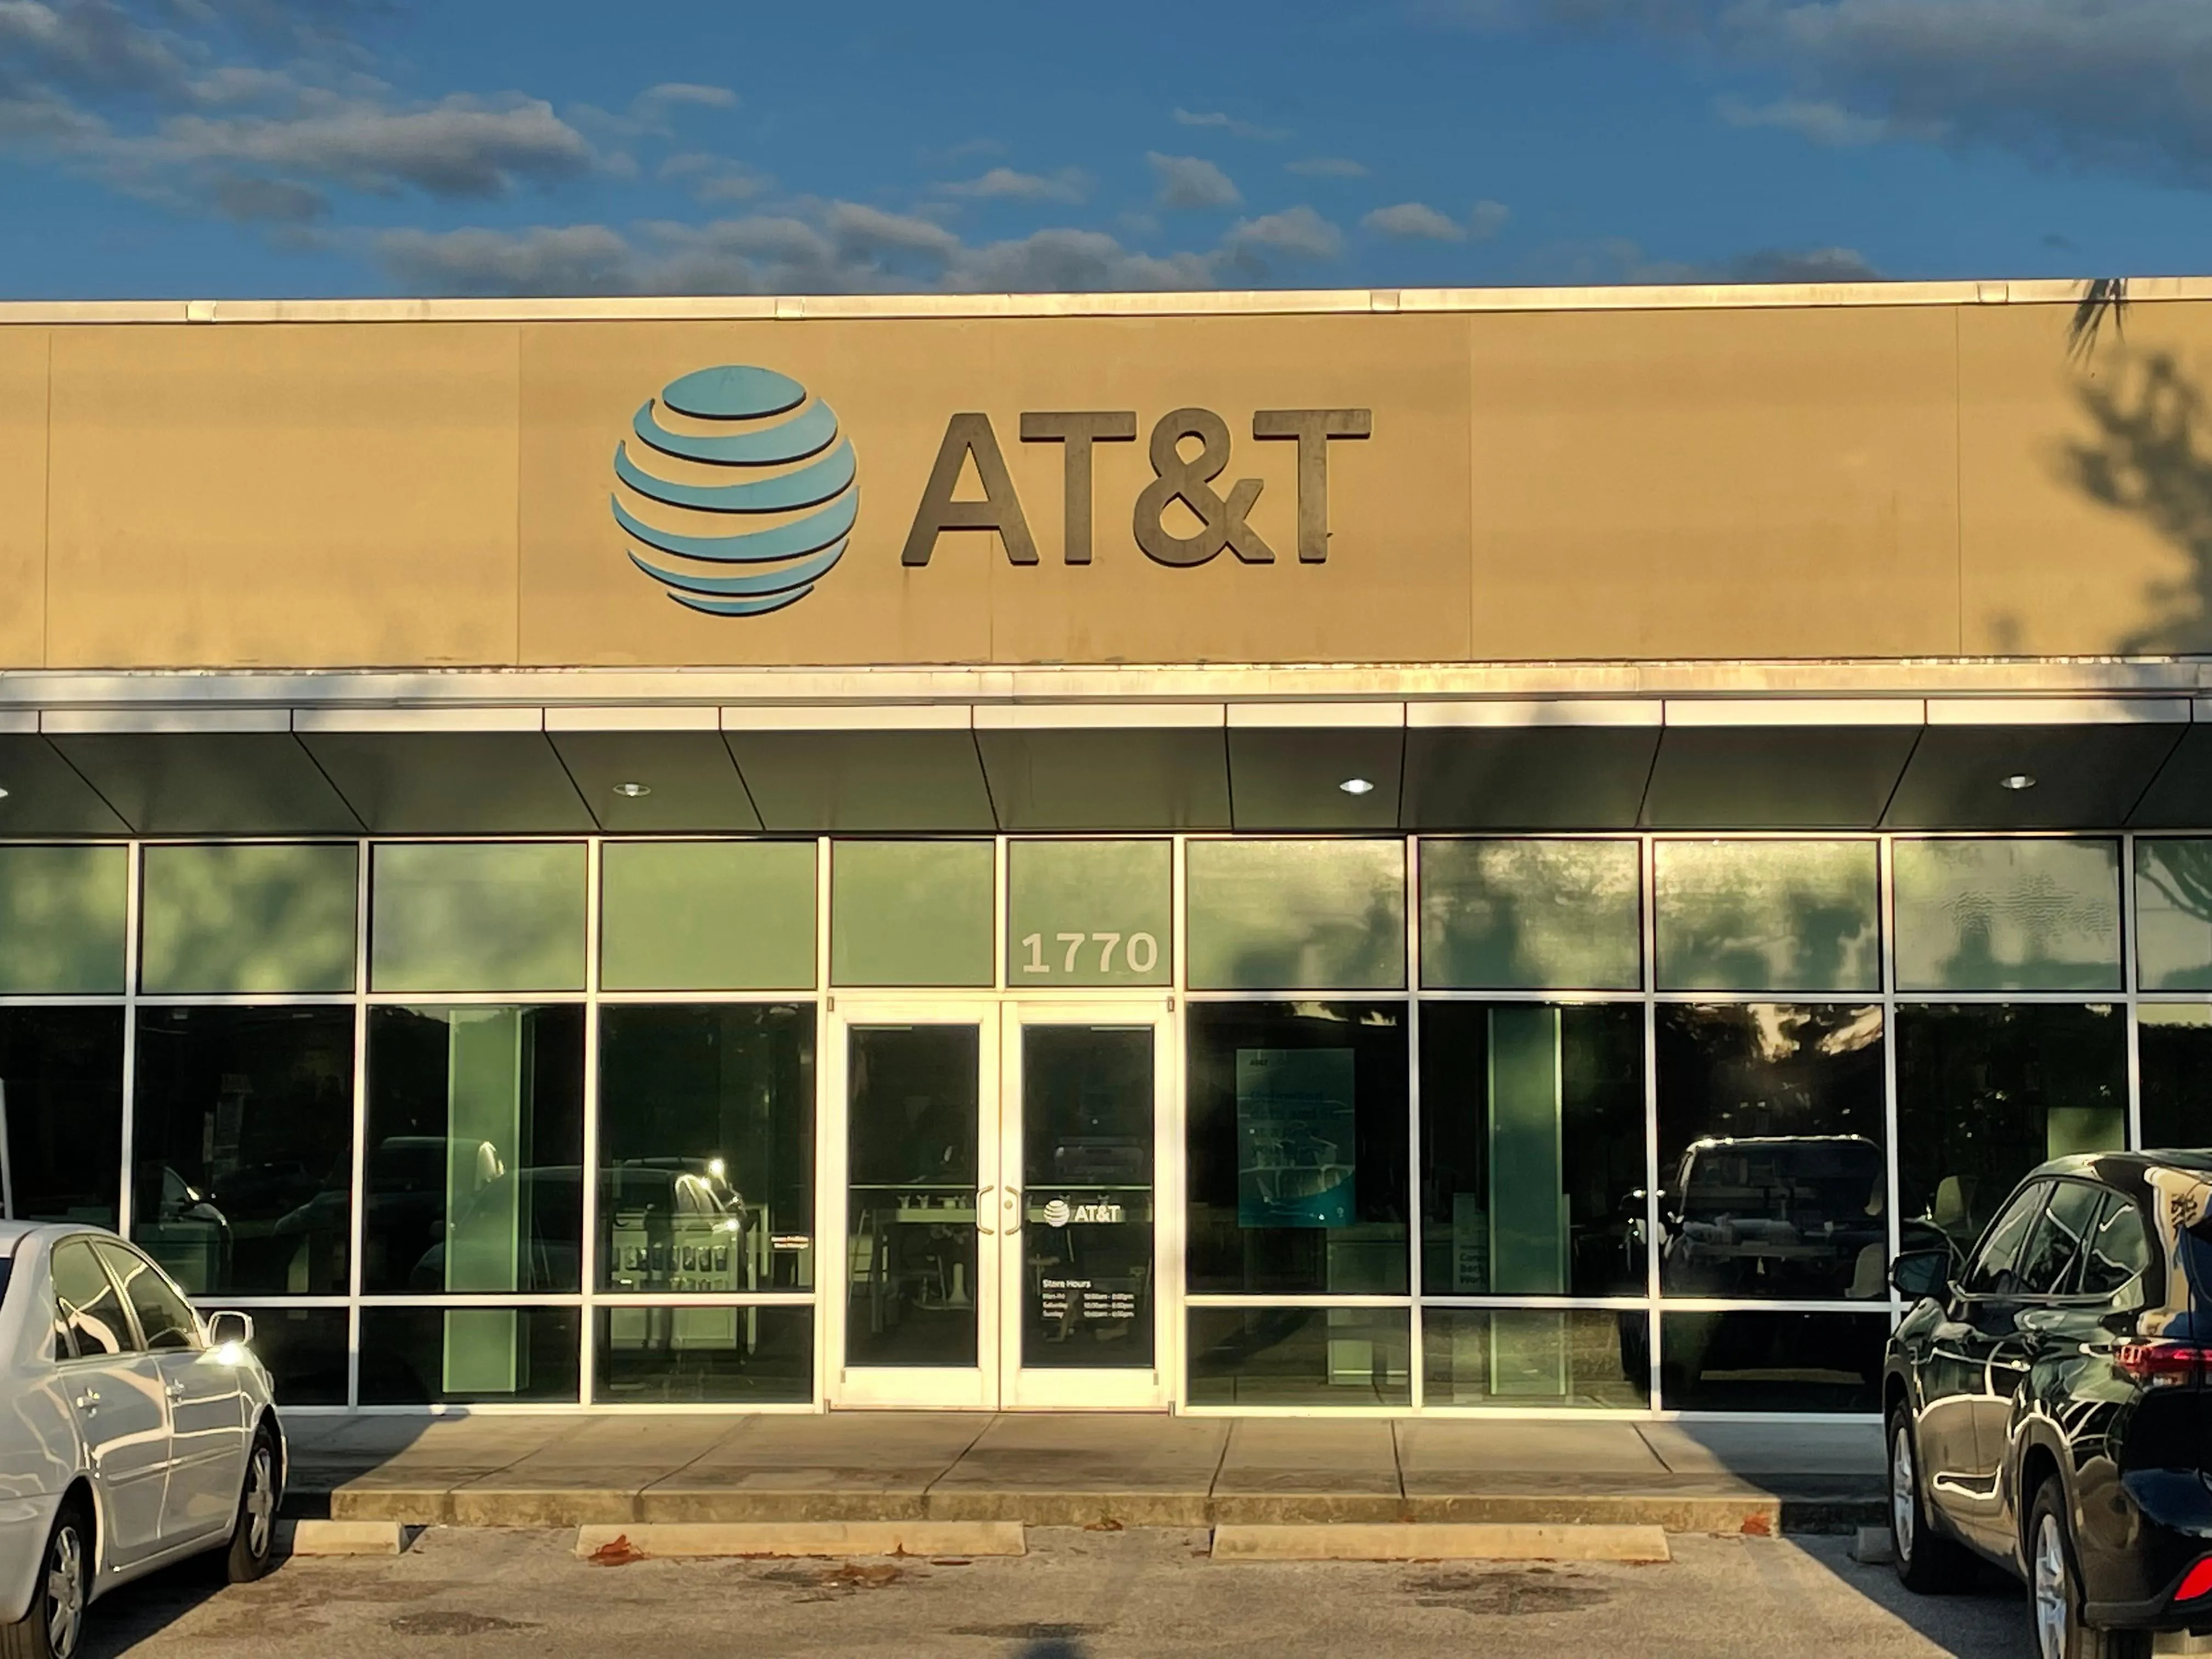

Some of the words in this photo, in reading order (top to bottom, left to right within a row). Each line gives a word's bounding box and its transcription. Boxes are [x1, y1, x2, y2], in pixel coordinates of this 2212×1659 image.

[901, 408, 1372, 567] AT&T
[1022, 932, 1158, 973] 1770
[1075, 1205, 1120, 1222] AT&T
[1066, 1280, 1091, 1288] Hours
